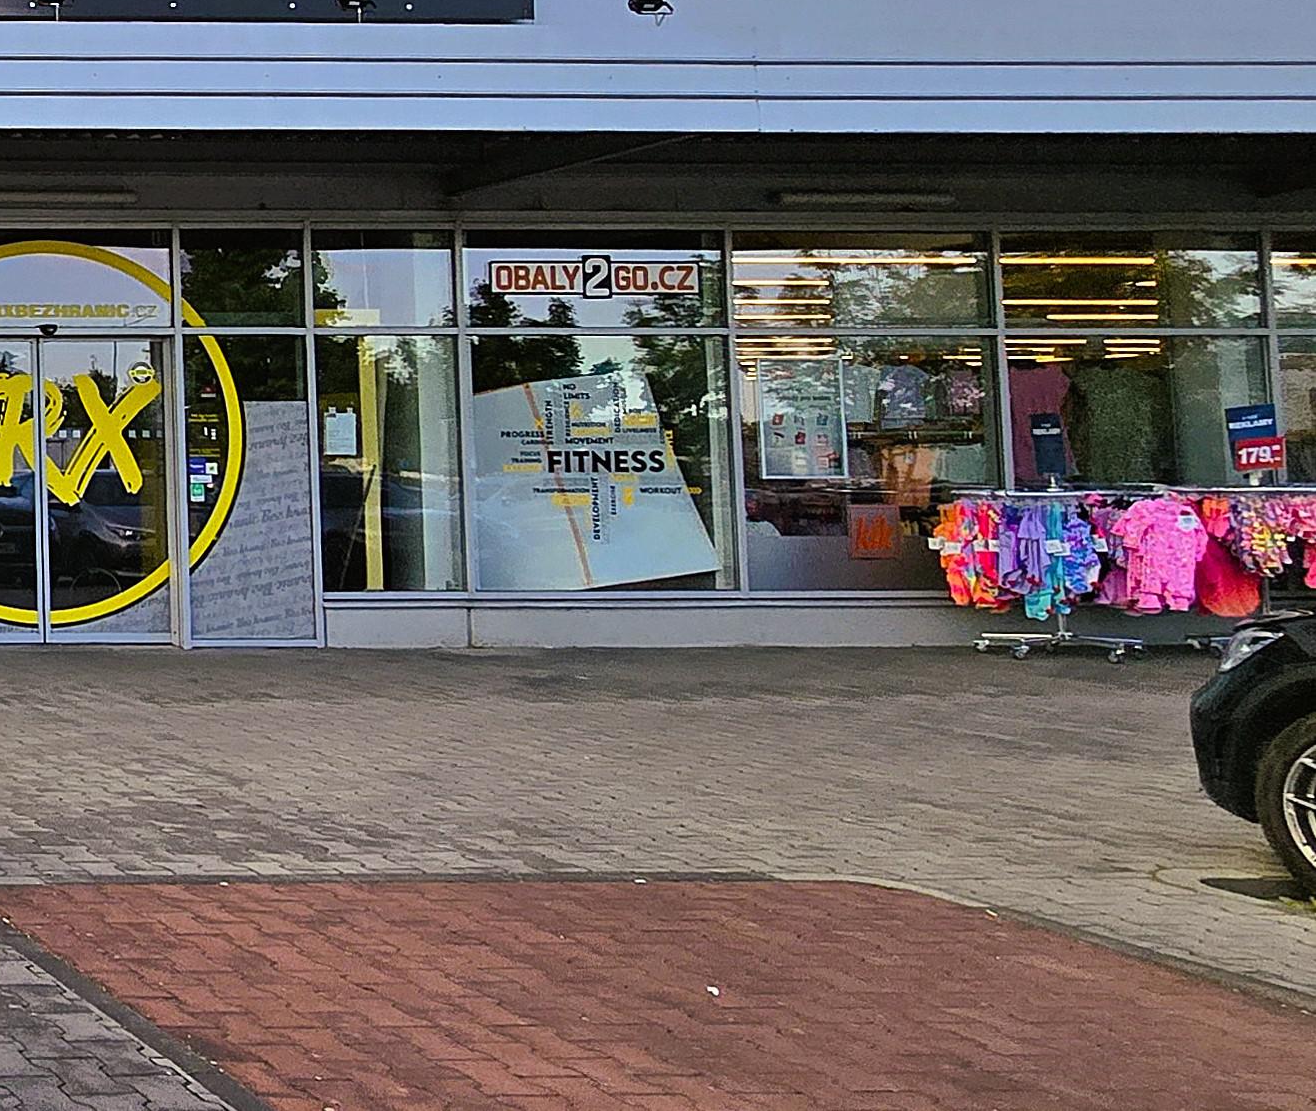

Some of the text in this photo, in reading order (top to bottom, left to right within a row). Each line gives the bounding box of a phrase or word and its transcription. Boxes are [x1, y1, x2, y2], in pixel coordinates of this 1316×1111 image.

[495, 258, 695, 296] OBALY2GO.CZ
[565, 437, 614, 445] MOVEMENT
[547, 450, 665, 473] FITNESS
